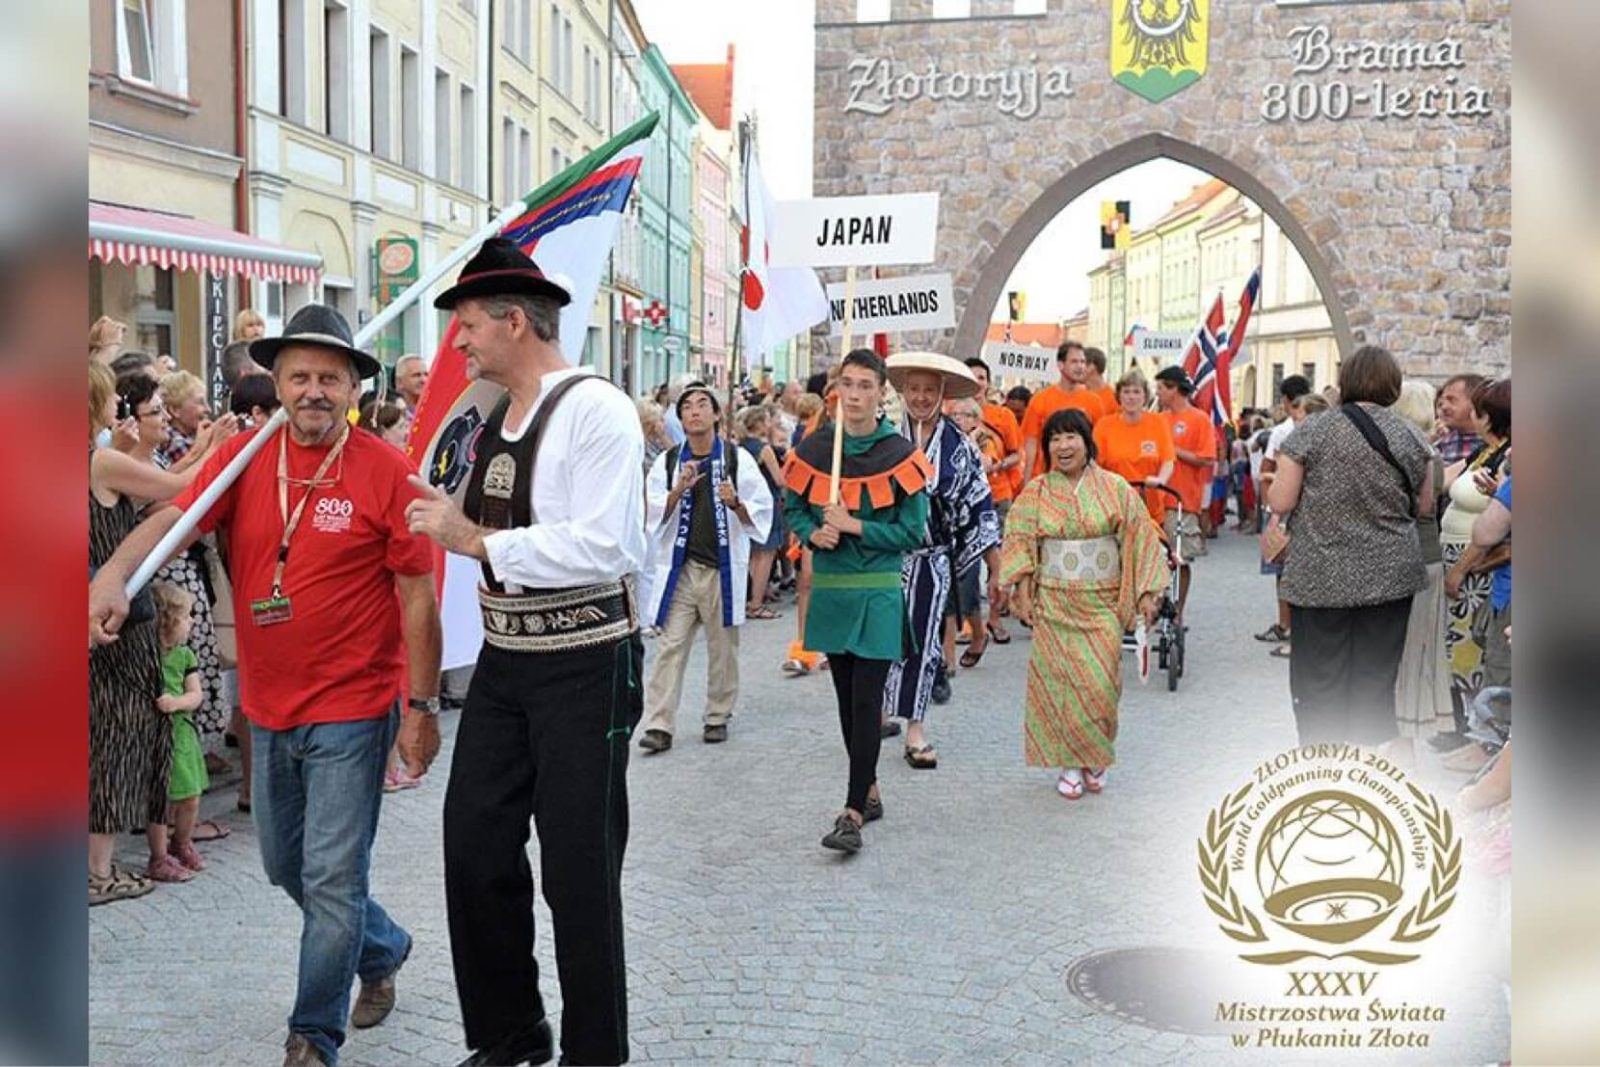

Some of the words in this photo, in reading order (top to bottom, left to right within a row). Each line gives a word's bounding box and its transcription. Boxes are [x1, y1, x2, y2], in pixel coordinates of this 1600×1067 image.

[1288, 24, 1465, 74] Brama
[844, 56, 1075, 118] Złotoryja
[1260, 76, 1492, 123] 800-lecia
[816, 214, 894, 247] JAPAN
[1143, 336, 1183, 350] SLOVAKIA
[998, 351, 1051, 371] NORWAY
[314, 498, 353, 517] 800
